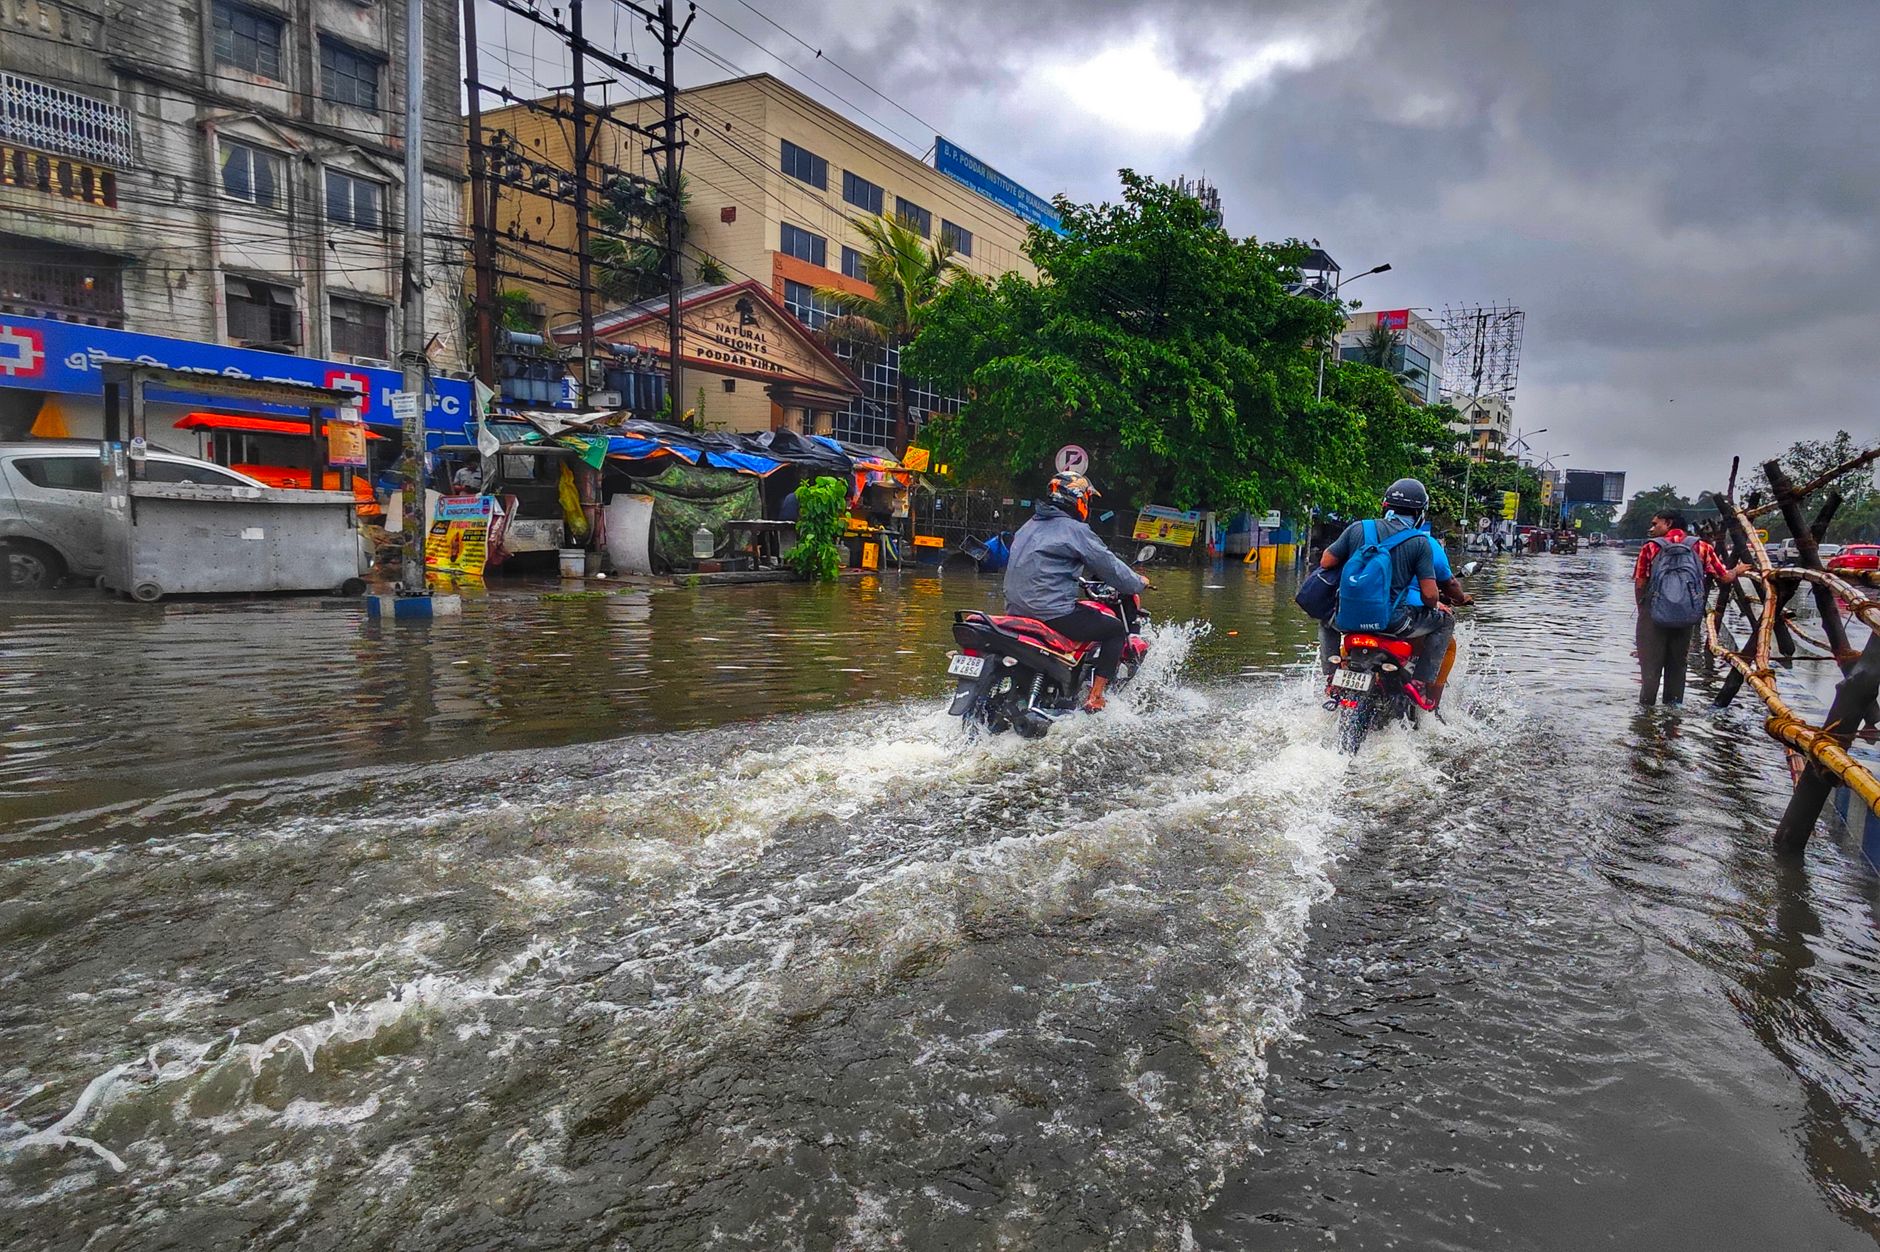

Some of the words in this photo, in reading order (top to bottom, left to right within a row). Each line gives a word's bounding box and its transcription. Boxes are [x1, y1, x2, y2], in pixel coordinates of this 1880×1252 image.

[944, 144, 951, 157] B.
[953, 150, 958, 162] P.
[960, 154, 986, 178] PODDAR
[986, 169, 1017, 196] INSTITUTE
[1018, 189, 1026, 201] OF
[715, 322, 767, 343] NATURAL
[715, 335, 767, 354] HEIGHTS
[697, 347, 747, 366] PODDAR
[751, 358, 784, 373] VIHAR
[382, 387, 460, 415] HFC
